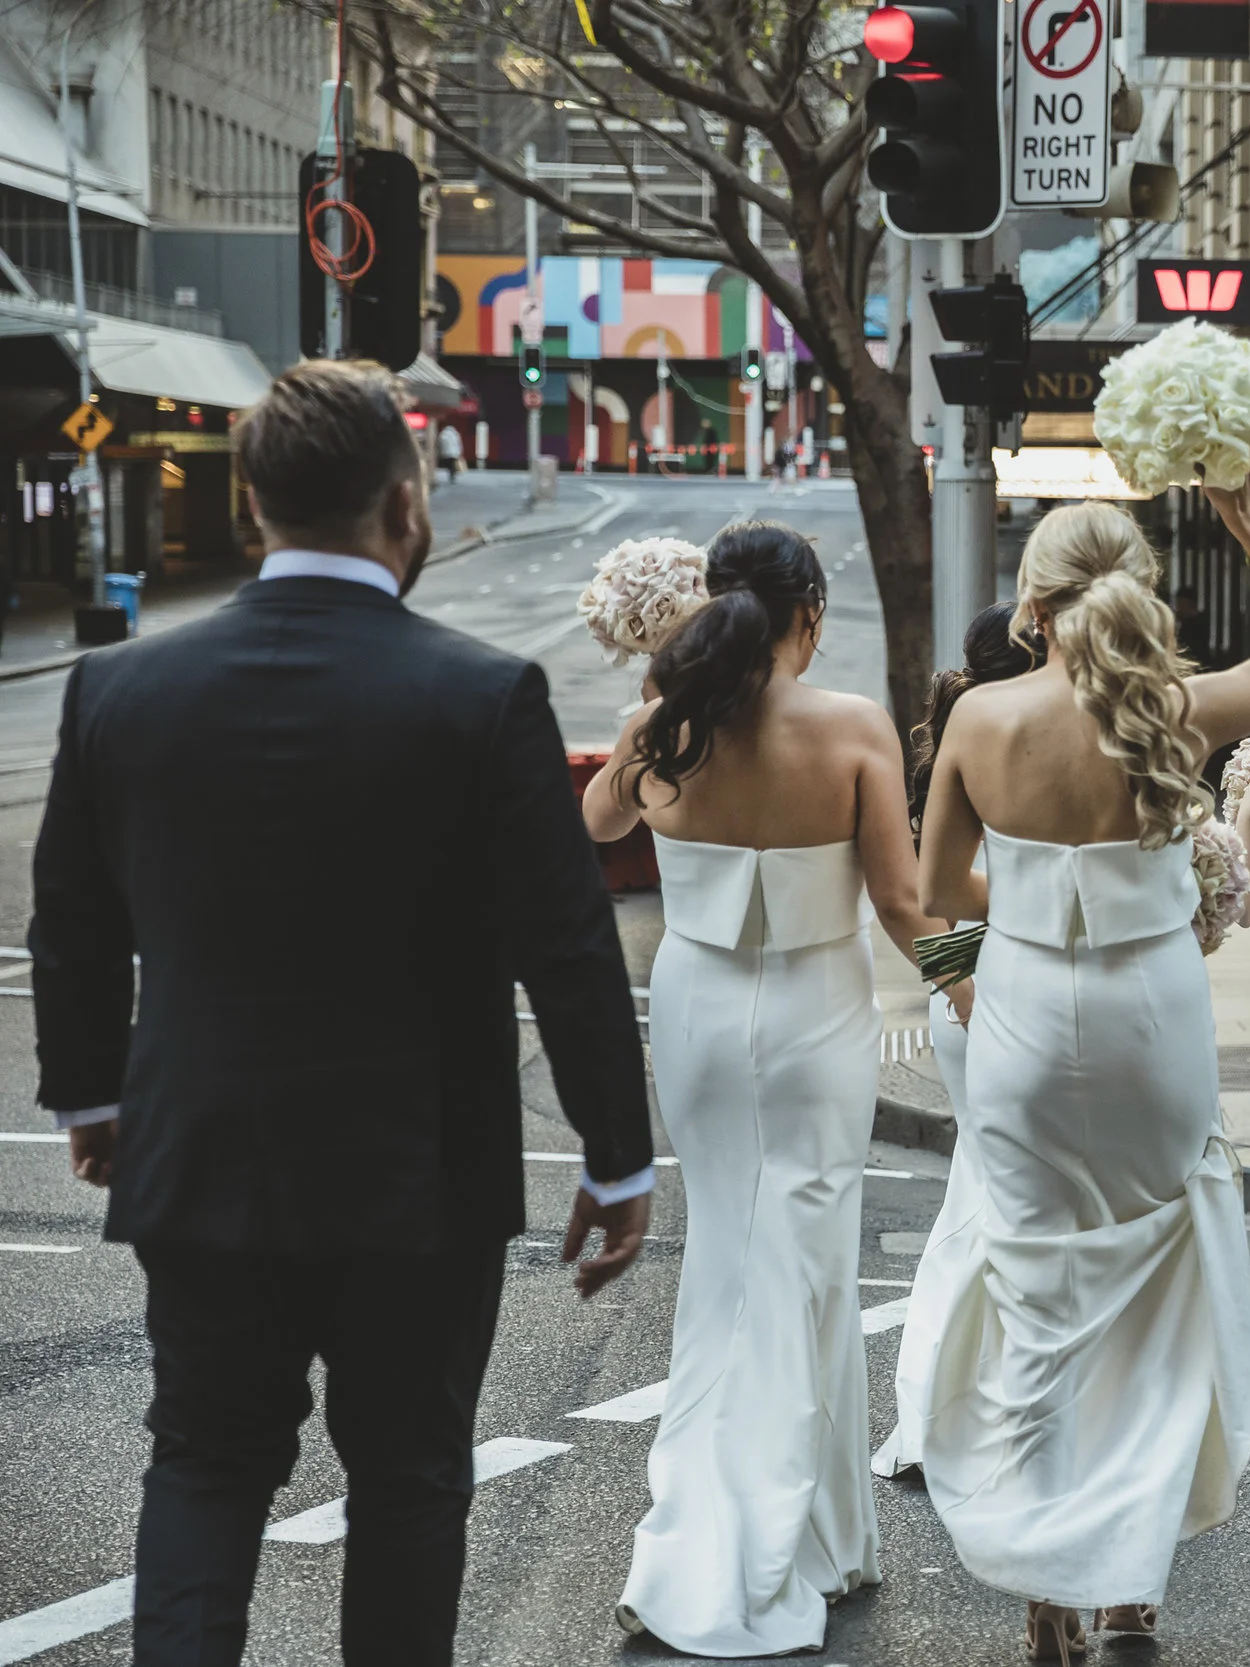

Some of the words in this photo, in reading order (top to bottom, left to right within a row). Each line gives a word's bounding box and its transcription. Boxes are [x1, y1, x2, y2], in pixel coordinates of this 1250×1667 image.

[1034, 93, 1083, 125] NO
[1023, 135, 1096, 158] RIGHT
[1023, 168, 1090, 190] TURN
